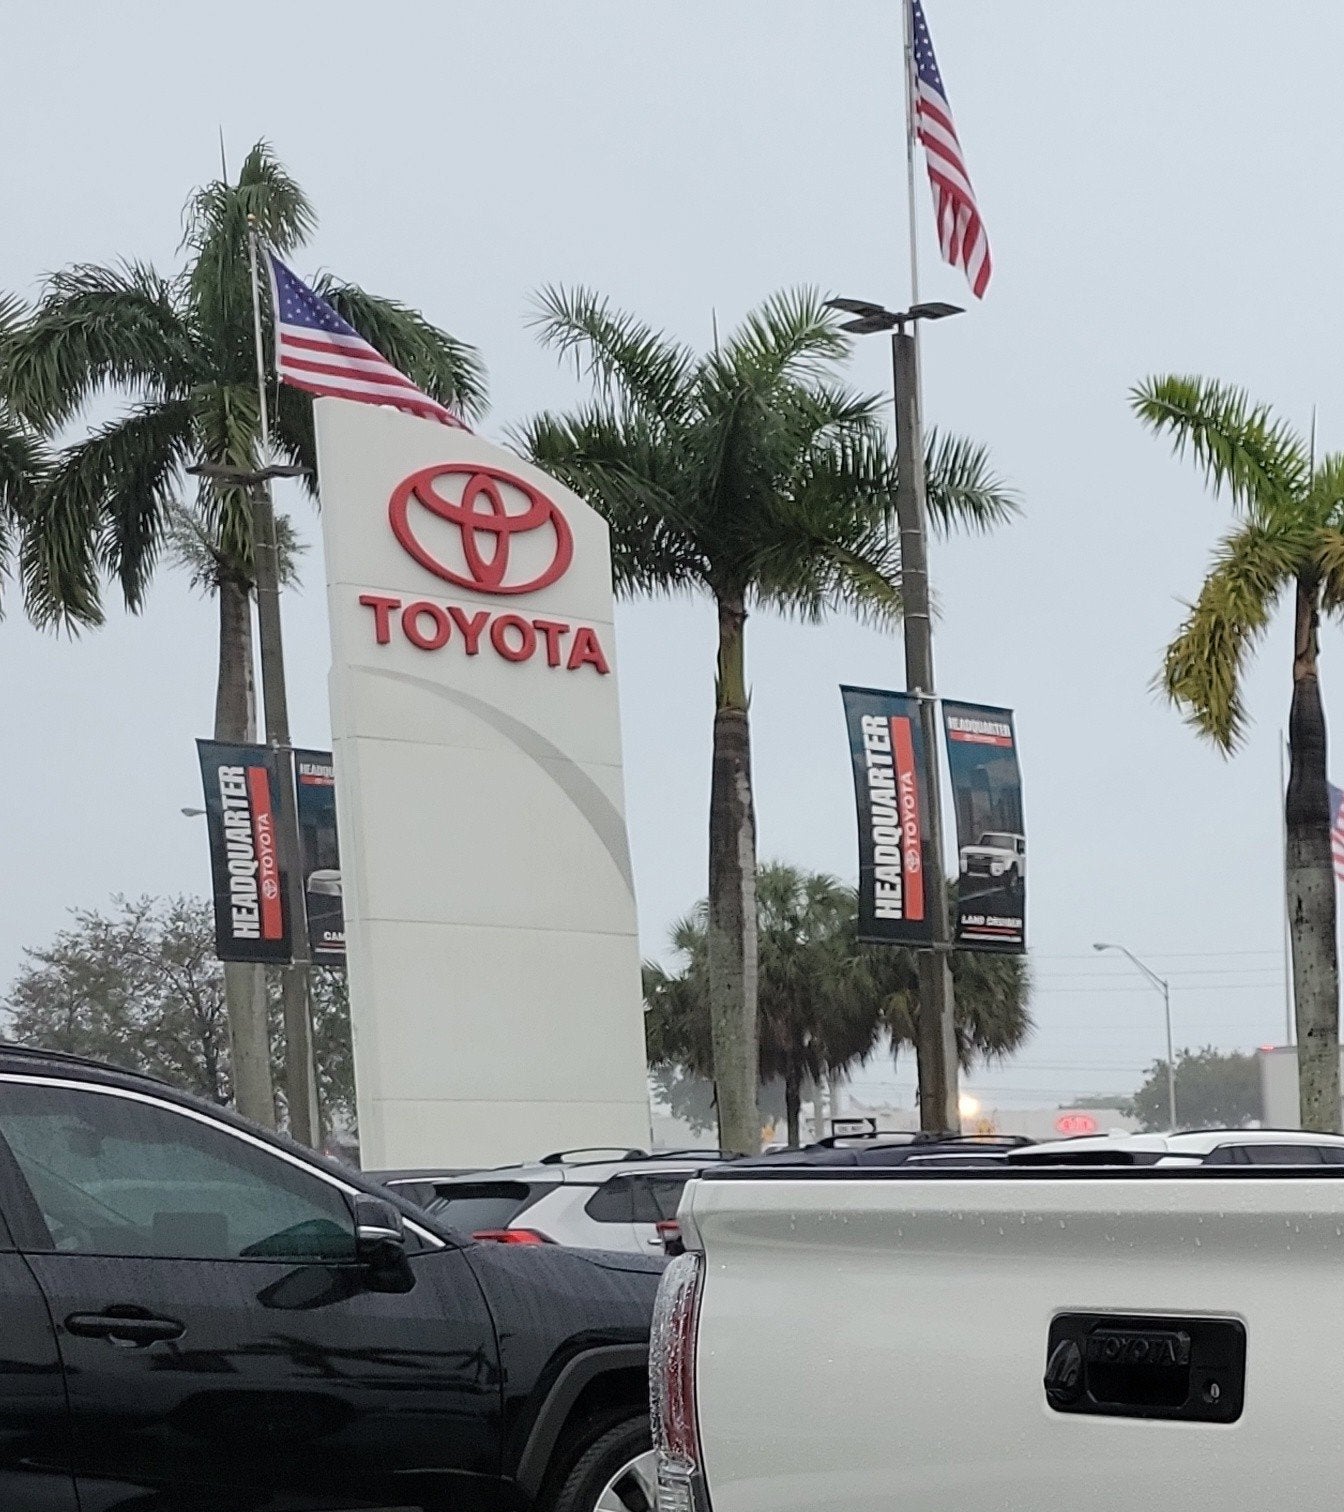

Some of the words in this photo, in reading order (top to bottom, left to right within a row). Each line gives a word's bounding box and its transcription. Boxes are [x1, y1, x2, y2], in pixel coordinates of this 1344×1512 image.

[359, 595, 610, 675] TOYOTA
[258, 812, 276, 875] TOYOTA
[861, 715, 903, 920] HEADQUARTER
[900, 771, 917, 847] TOYOTA
[218, 765, 261, 940] HEADQUARTER
